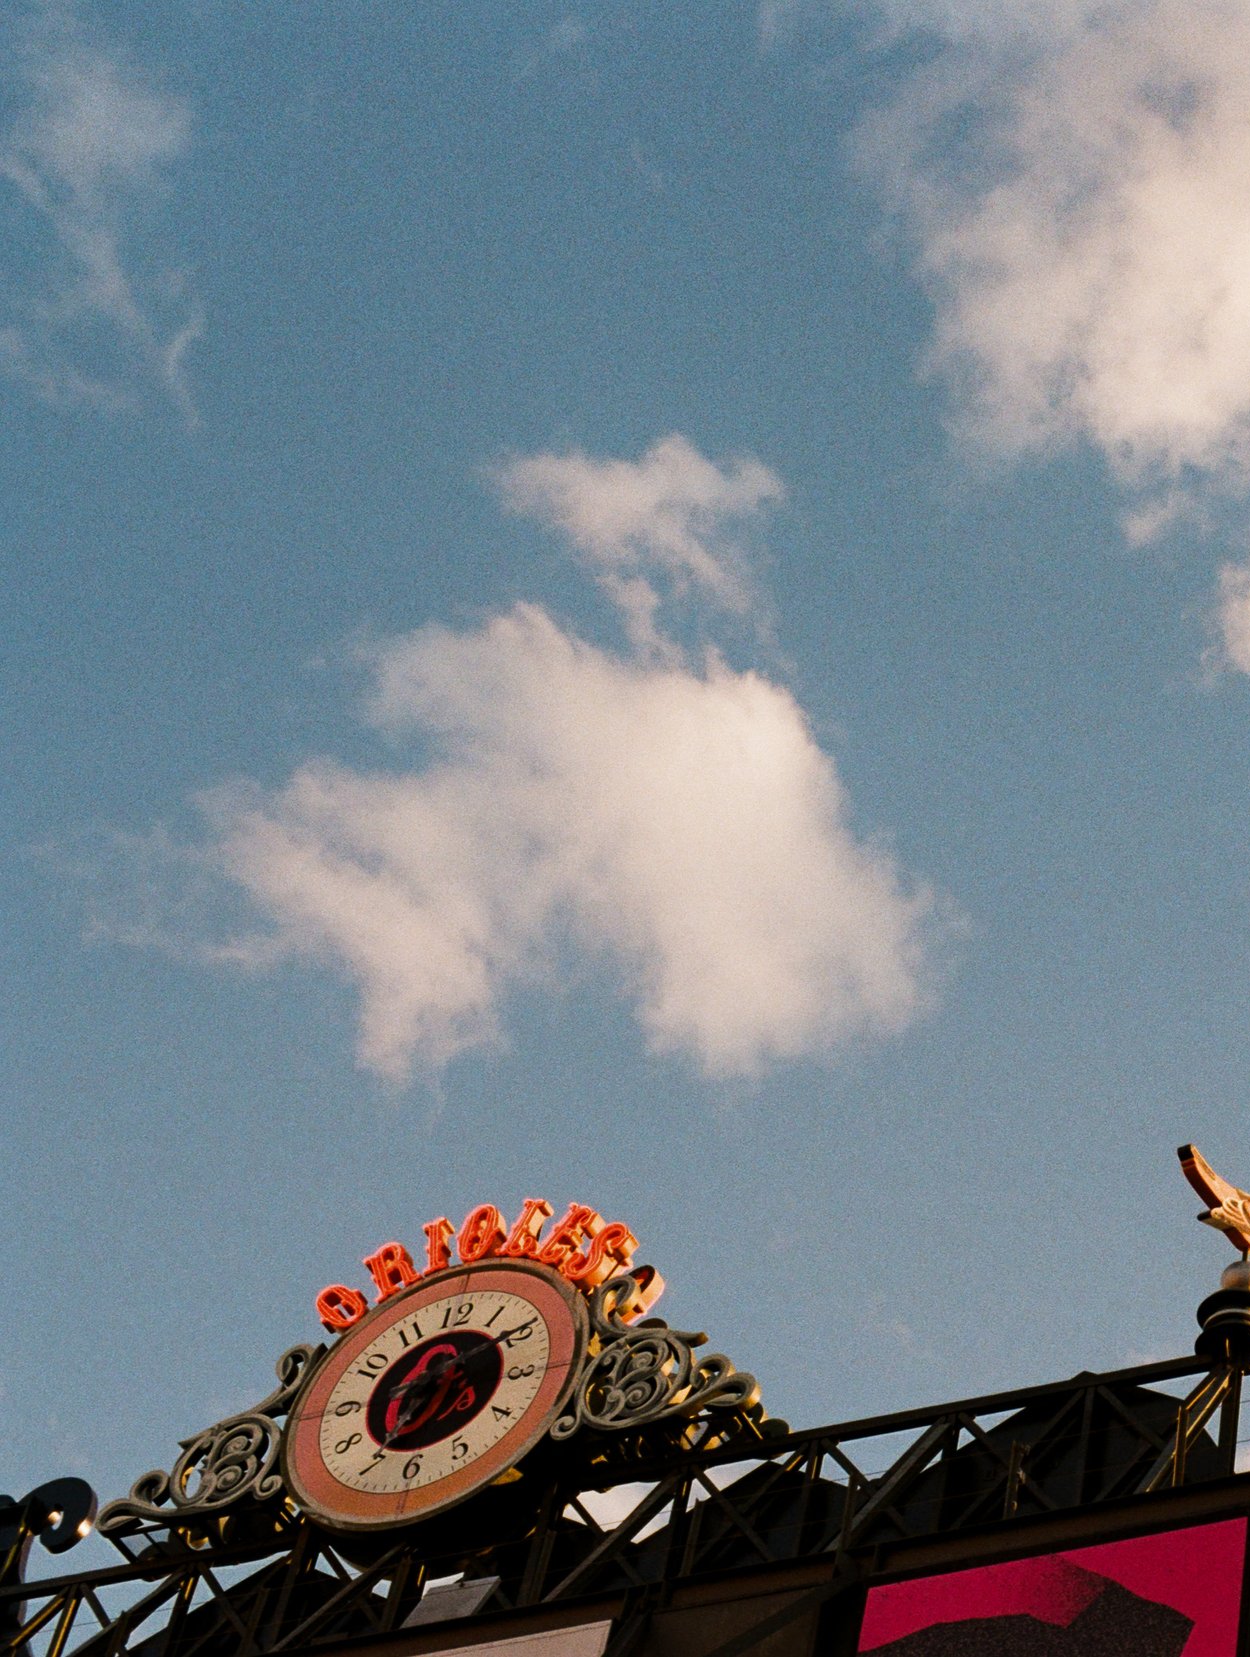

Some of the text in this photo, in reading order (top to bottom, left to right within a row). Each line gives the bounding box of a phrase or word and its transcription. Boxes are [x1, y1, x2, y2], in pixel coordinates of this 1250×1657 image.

[316, 1198, 639, 1333] ORIOLES
[440, 1303, 475, 1328] 12
[484, 1305, 506, 1328] 1
[399, 1322, 424, 1348] 11
[505, 1326, 533, 1348] 2
[358, 1353, 388, 1381] 10
[508, 1364, 535, 1380] 3
[335, 1400, 361, 1417] 9
[491, 1404, 512, 1424] 4
[335, 1432, 362, 1454] 8
[452, 1437, 470, 1461] 5
[358, 1454, 387, 1476] 7
[402, 1454, 424, 1480] 6
